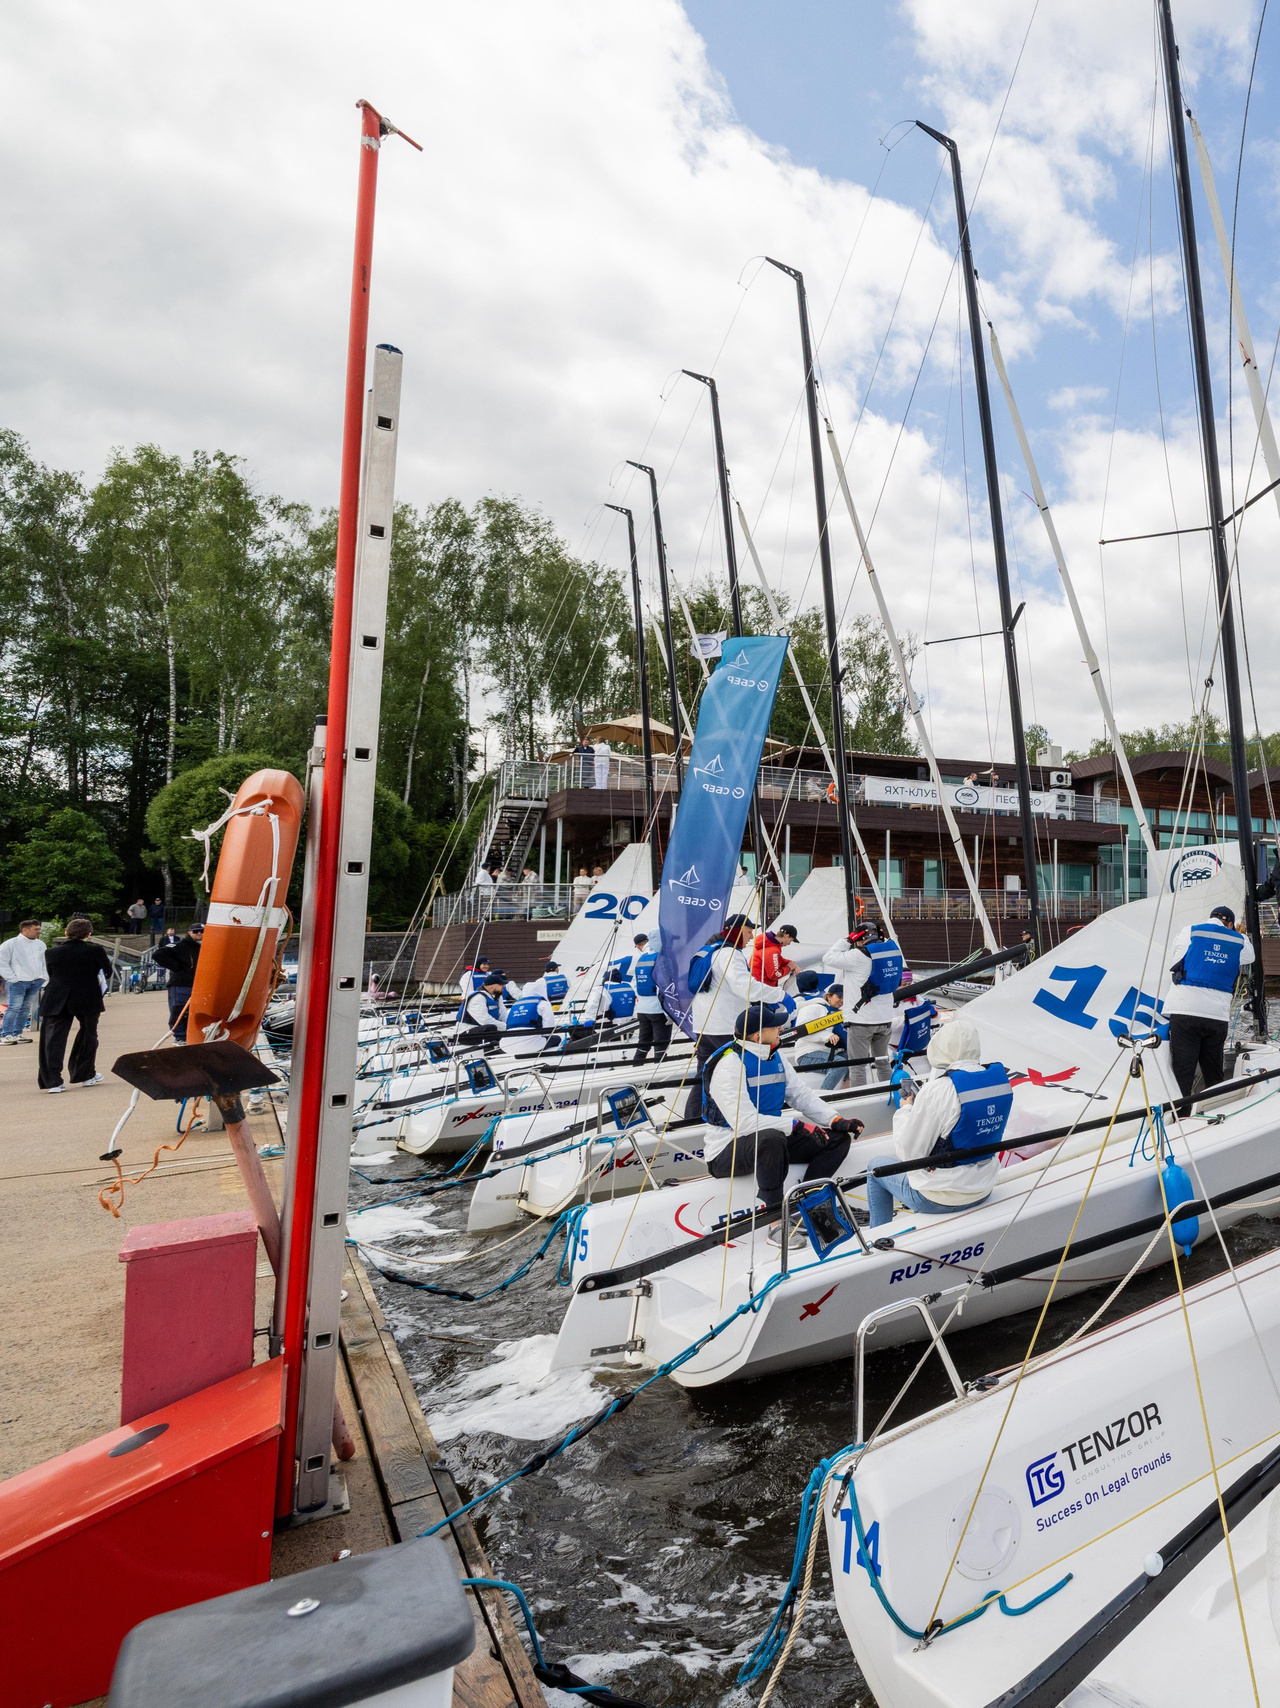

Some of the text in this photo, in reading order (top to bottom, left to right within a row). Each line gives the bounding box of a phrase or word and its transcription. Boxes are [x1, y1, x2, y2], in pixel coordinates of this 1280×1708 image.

[884, 785, 937, 799] ЯХТ-КЛУБ
[585, 893, 650, 920] 20
[1203, 950, 1229, 959] TENZOR
[976, 1115, 1004, 1127] TENZOR
[889, 1242, 985, 1285] RUS 7286
[1061, 1402, 1163, 1472] TENZOR
[1075, 1449, 1132, 1486] CONSULTING
[1036, 1451, 1172, 1533] Success On Legal Grounds
[840, 1507, 882, 1589] 14
